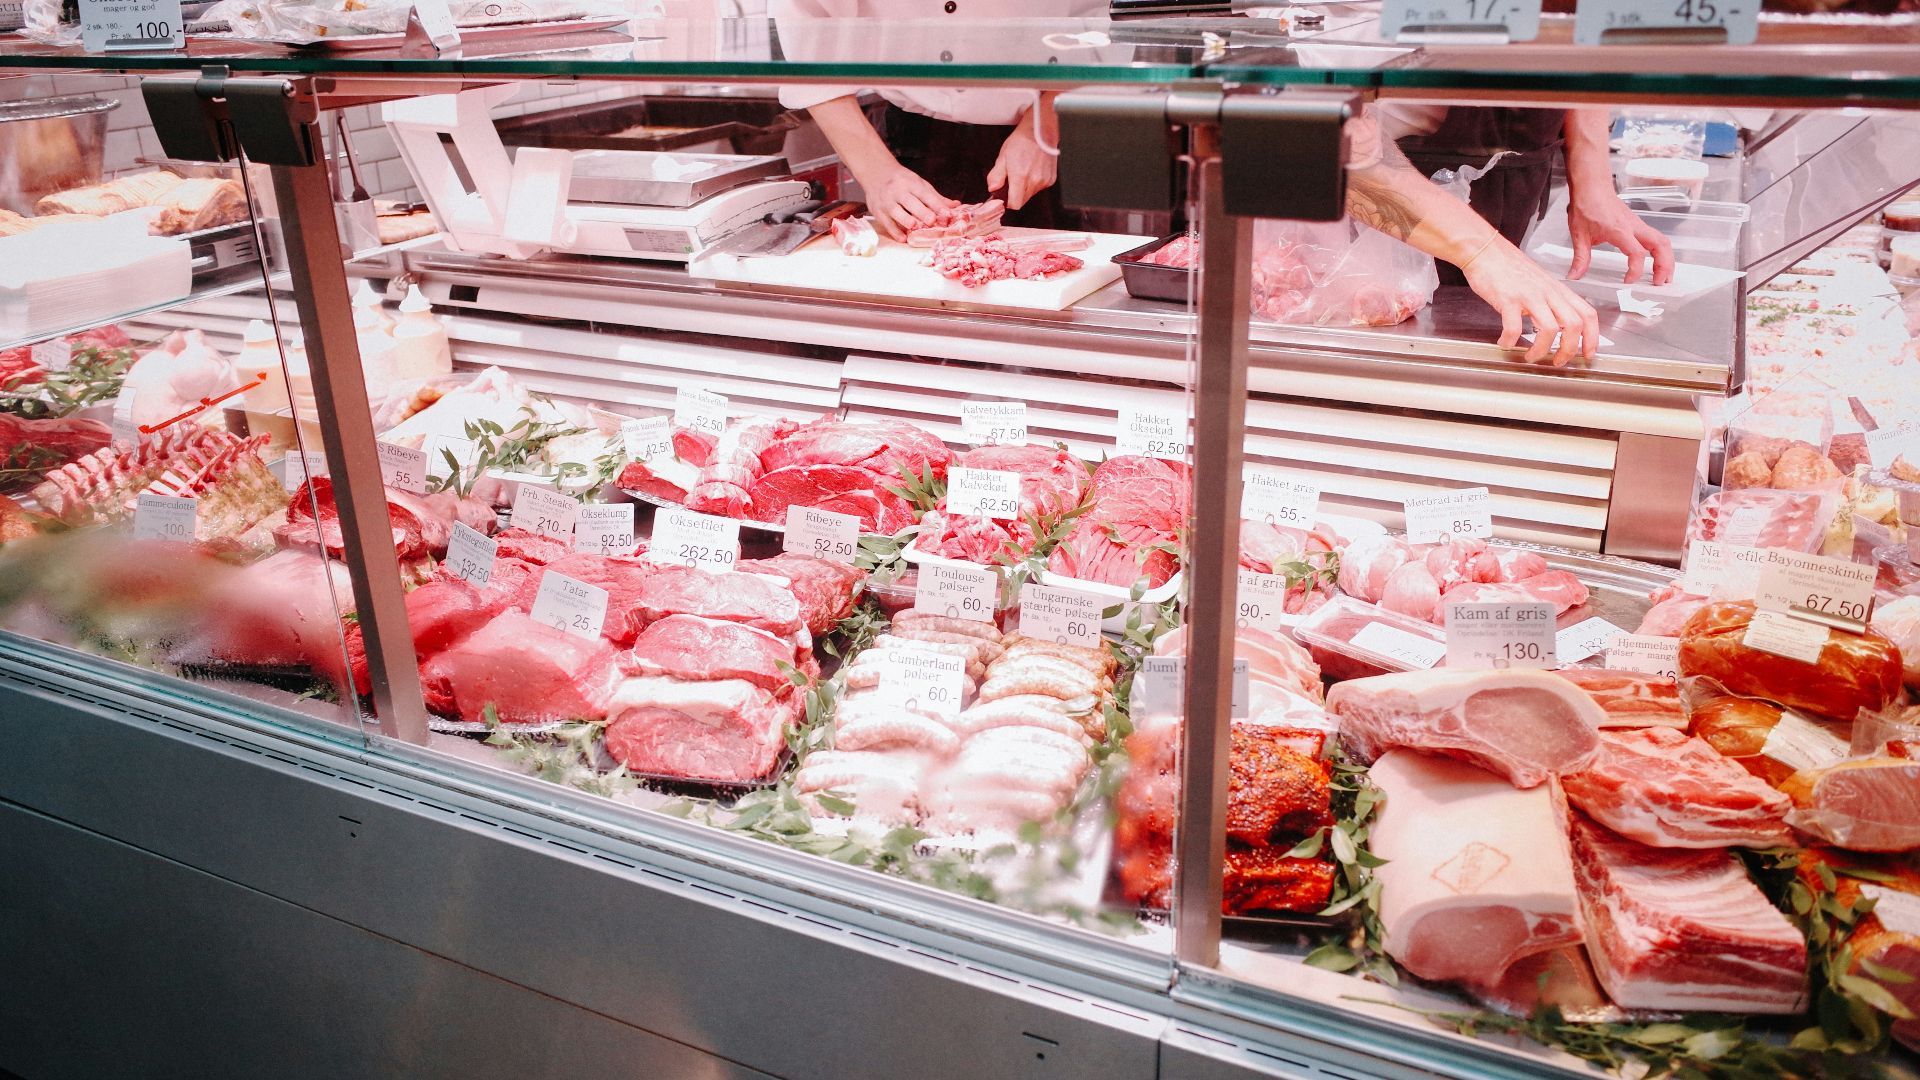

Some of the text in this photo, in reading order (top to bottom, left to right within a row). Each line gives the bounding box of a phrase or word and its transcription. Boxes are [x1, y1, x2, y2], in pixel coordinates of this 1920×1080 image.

[136, 21, 182, 39] 100,-
[963, 404, 1025, 416] Kalvetykkam
[696, 416, 723, 431] 52,50
[1135, 412, 1170, 426] Hakket
[991, 428, 1025, 441] 67,50
[387, 445, 420, 462] Ribeye
[1148, 440, 1185, 456] 62,50
[395, 469, 420, 486] 55,-
[966, 470, 1002, 483] Hakket
[1252, 473, 1290, 490] Hakket
[138, 496, 196, 511] Lammeculotte
[543, 493, 574, 511] Steaks
[980, 497, 1017, 513] 62,50
[581, 508, 628, 520] Okseklump
[806, 511, 842, 528] Ribeye
[1280, 506, 1307, 523] 55,-
[164, 523, 193, 537] 100,-
[537, 516, 567, 535] 210,-
[670, 514, 725, 532] Oksefilet
[1453, 519, 1483, 533] 85,-
[601, 534, 632, 549] 92,50
[814, 538, 852, 556] 52,50
[679, 543, 733, 565] 262,50
[463, 558, 489, 583] 132,50
[932, 566, 985, 584] Toulouse
[1767, 551, 1874, 584] Bayonneskinke
[563, 579, 589, 598] Tatar
[940, 579, 976, 594] pølser
[1247, 575, 1259, 586] af
[1262, 577, 1285, 590] gris
[963, 597, 992, 615] 60,-
[1032, 587, 1095, 608] Ungarnske
[1023, 600, 1101, 622] stærke pølser
[1240, 602, 1271, 622] 90,-
[1454, 606, 1548, 622] Kam af gris
[572, 614, 598, 632] 25,-
[1067, 621, 1098, 640] 60,-
[1502, 642, 1554, 662] 130,-
[1605, 648, 1635, 657] Pølser
[1647, 652, 1678, 662] mange
[889, 651, 960, 671] Cumberland
[904, 668, 942, 681] pølser
[928, 686, 958, 705] 60,-
